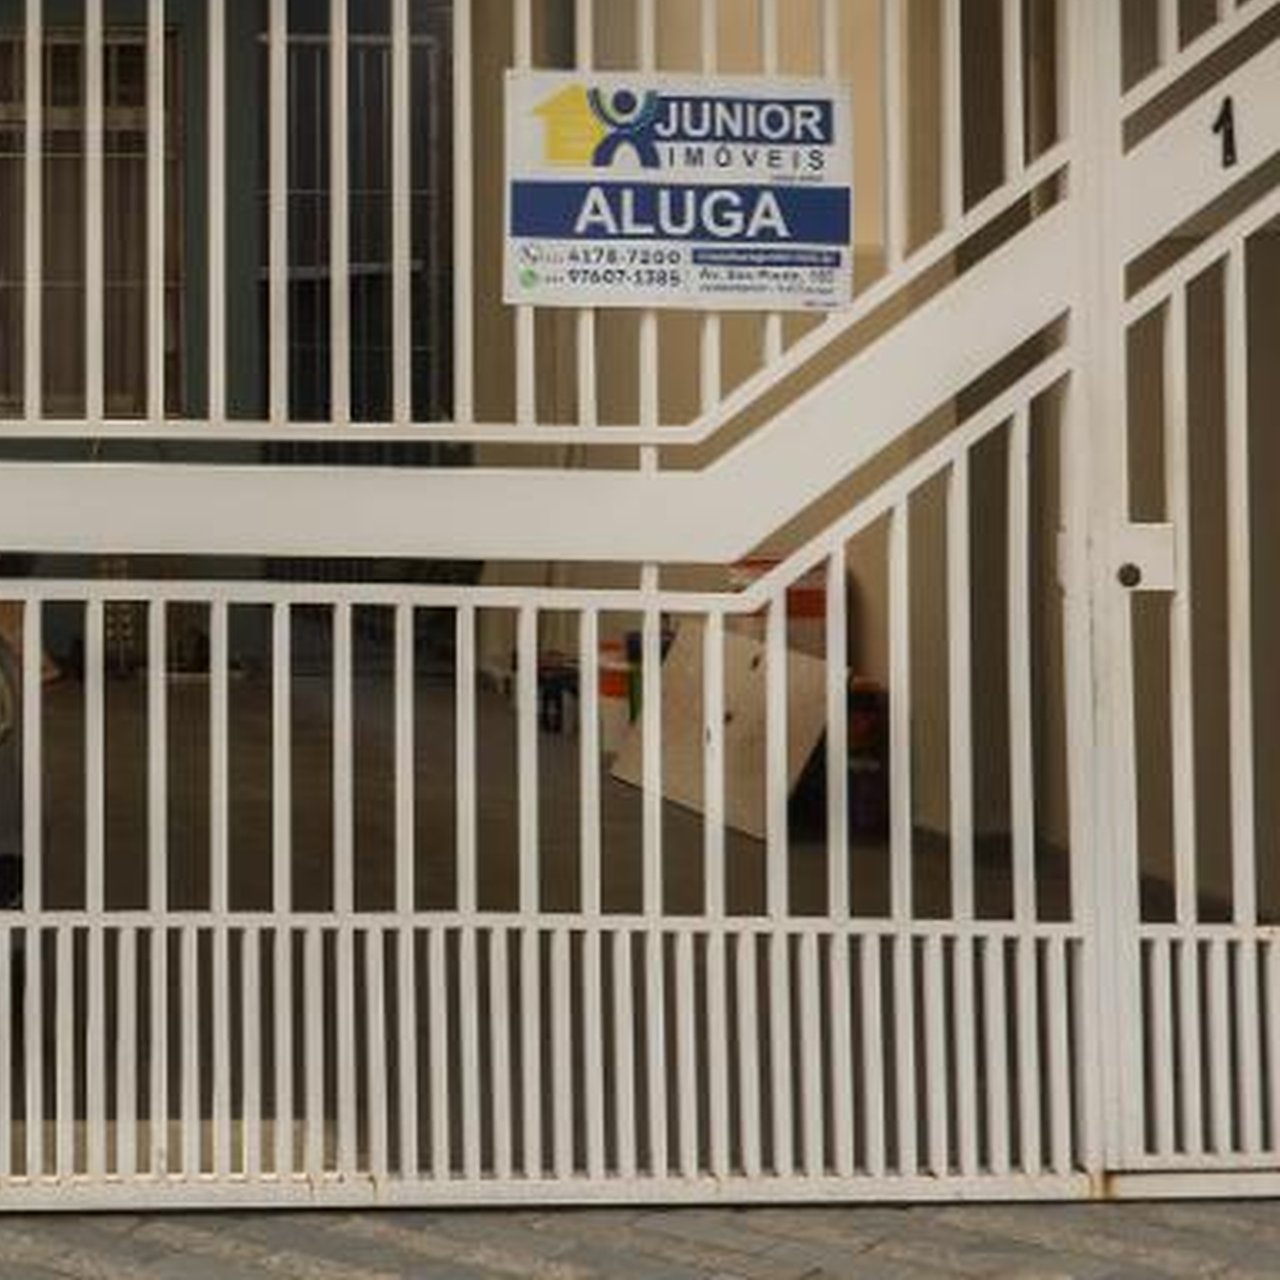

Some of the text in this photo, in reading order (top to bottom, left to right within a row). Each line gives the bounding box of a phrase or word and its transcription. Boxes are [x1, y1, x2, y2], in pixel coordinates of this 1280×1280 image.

[654, 101, 825, 140] JUNIOR
[1212, 95, 1238, 169] 1
[669, 145, 825, 170] IMÓVEIS
[573, 186, 790, 238] ALUGA
